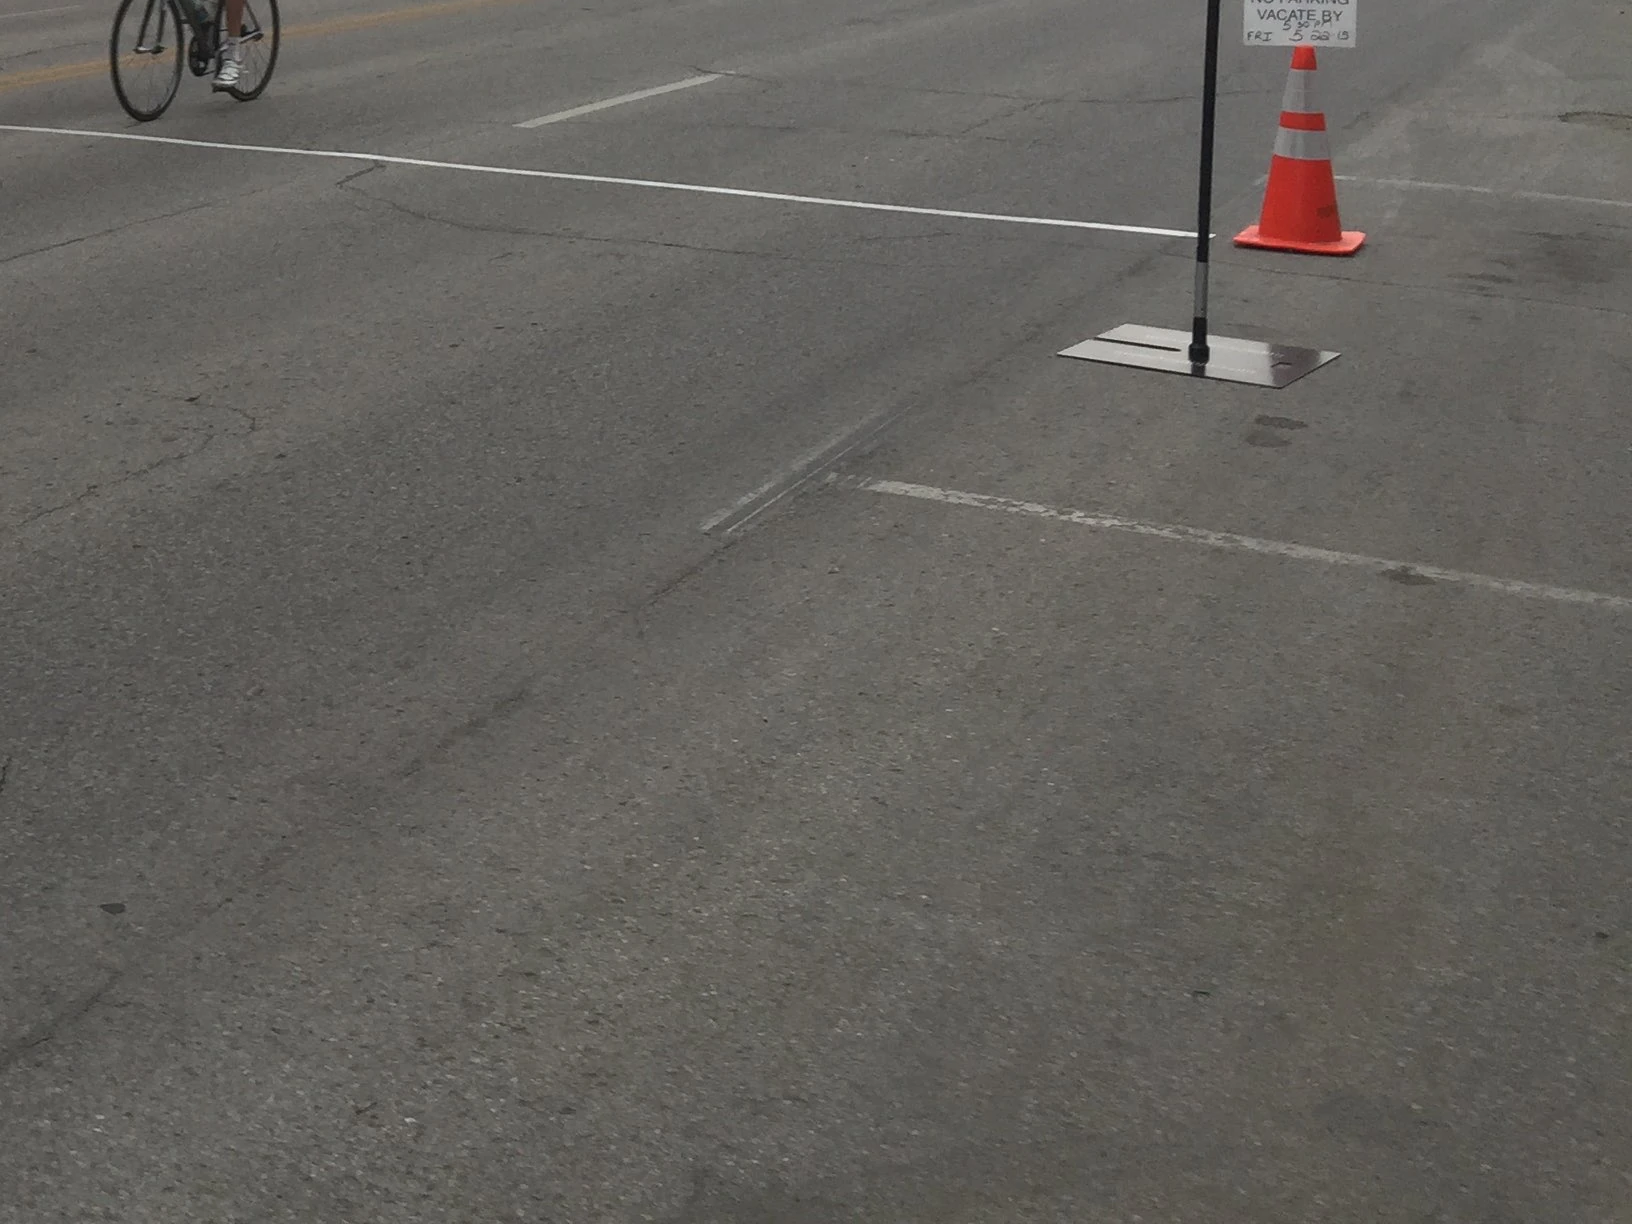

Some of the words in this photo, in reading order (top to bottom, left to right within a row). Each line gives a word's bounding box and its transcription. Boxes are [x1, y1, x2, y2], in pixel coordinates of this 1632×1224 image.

[1257, 9, 1316, 21] VACATE
[1322, 10, 1343, 22] BY
[1247, 31, 1273, 42] FRI
